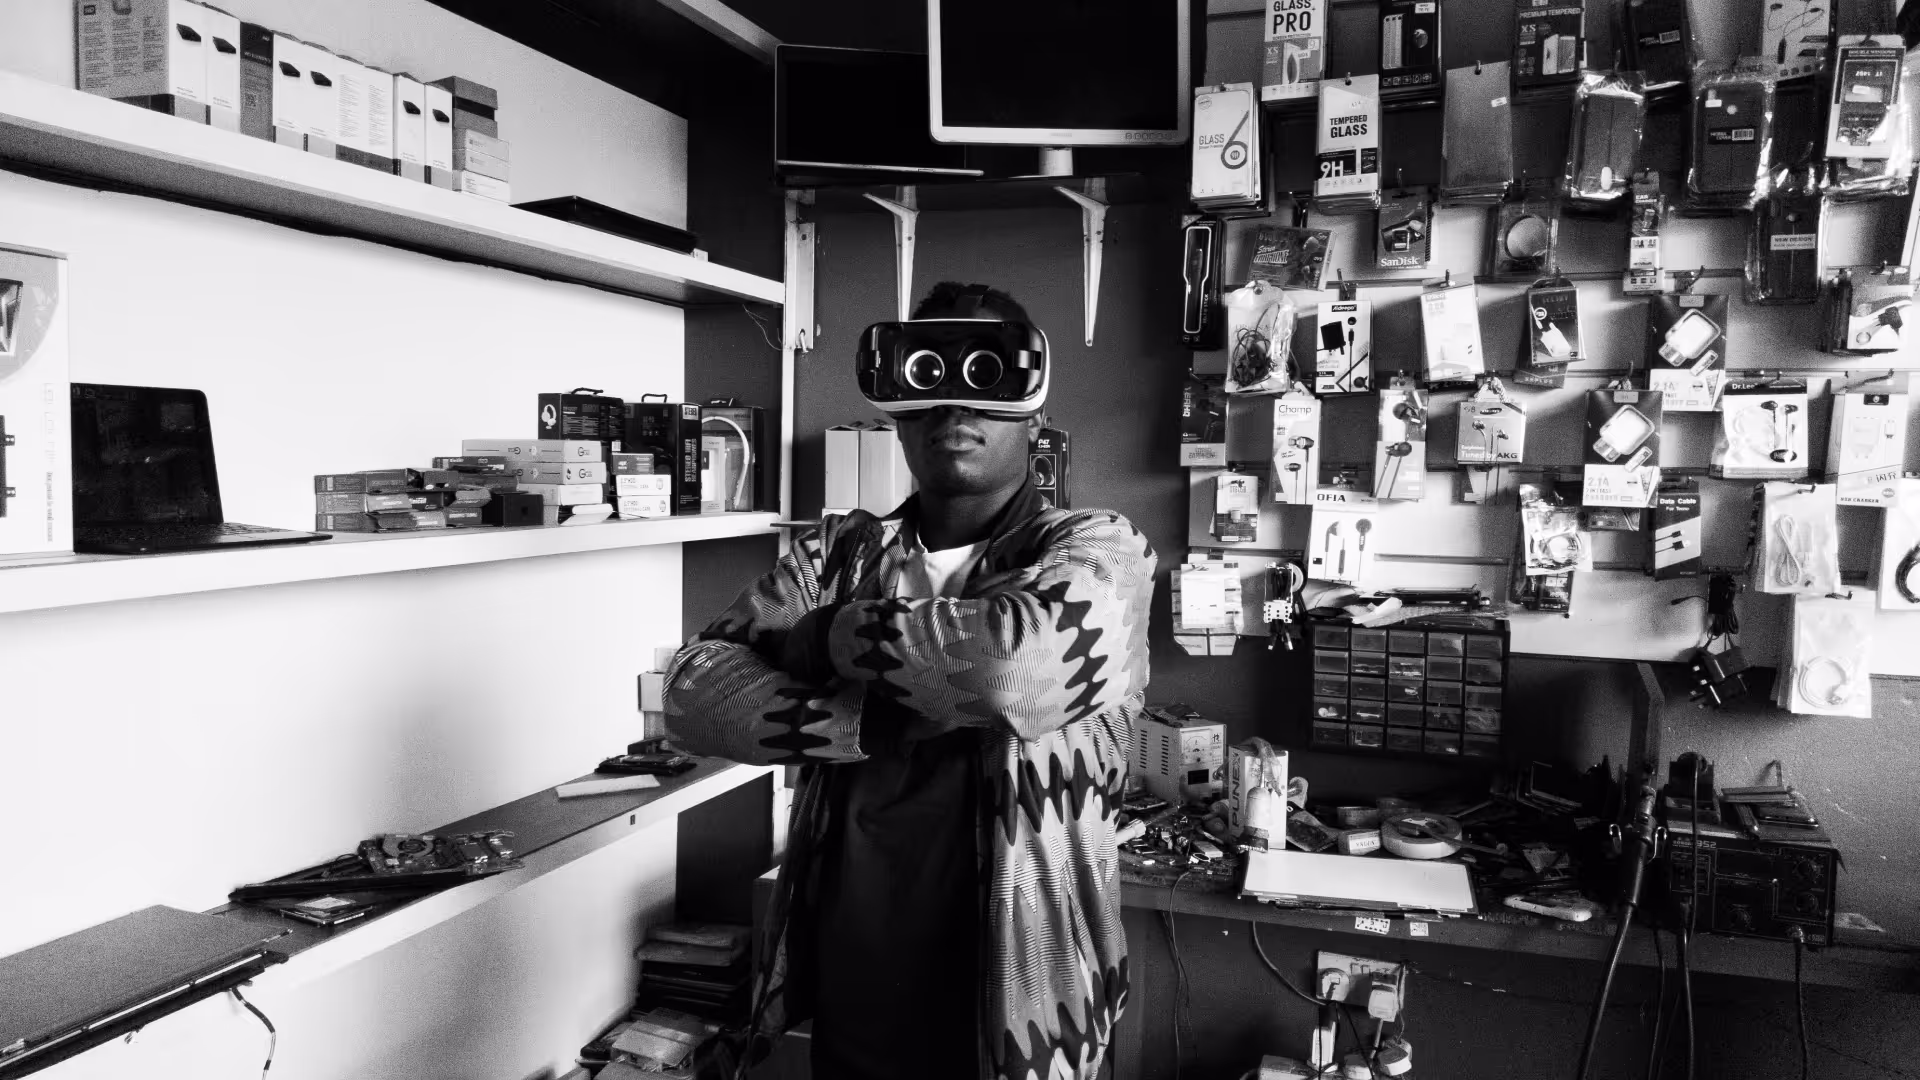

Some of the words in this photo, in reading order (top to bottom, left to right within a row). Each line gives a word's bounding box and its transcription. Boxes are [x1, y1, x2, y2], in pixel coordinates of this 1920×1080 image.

[1273, 0, 1311, 12] GLASS
[1273, 11, 1311, 34] PRO
[1330, 115, 1368, 126] TEMPERED
[1331, 124, 1368, 138] GLASS
[1199, 134, 1225, 145] GLASS
[1320, 161, 1344, 180] 9H
[1380, 256, 1421, 267] SanDisk
[1278, 404, 1312, 416] Champ
[1461, 451, 1485, 459] Tuned
